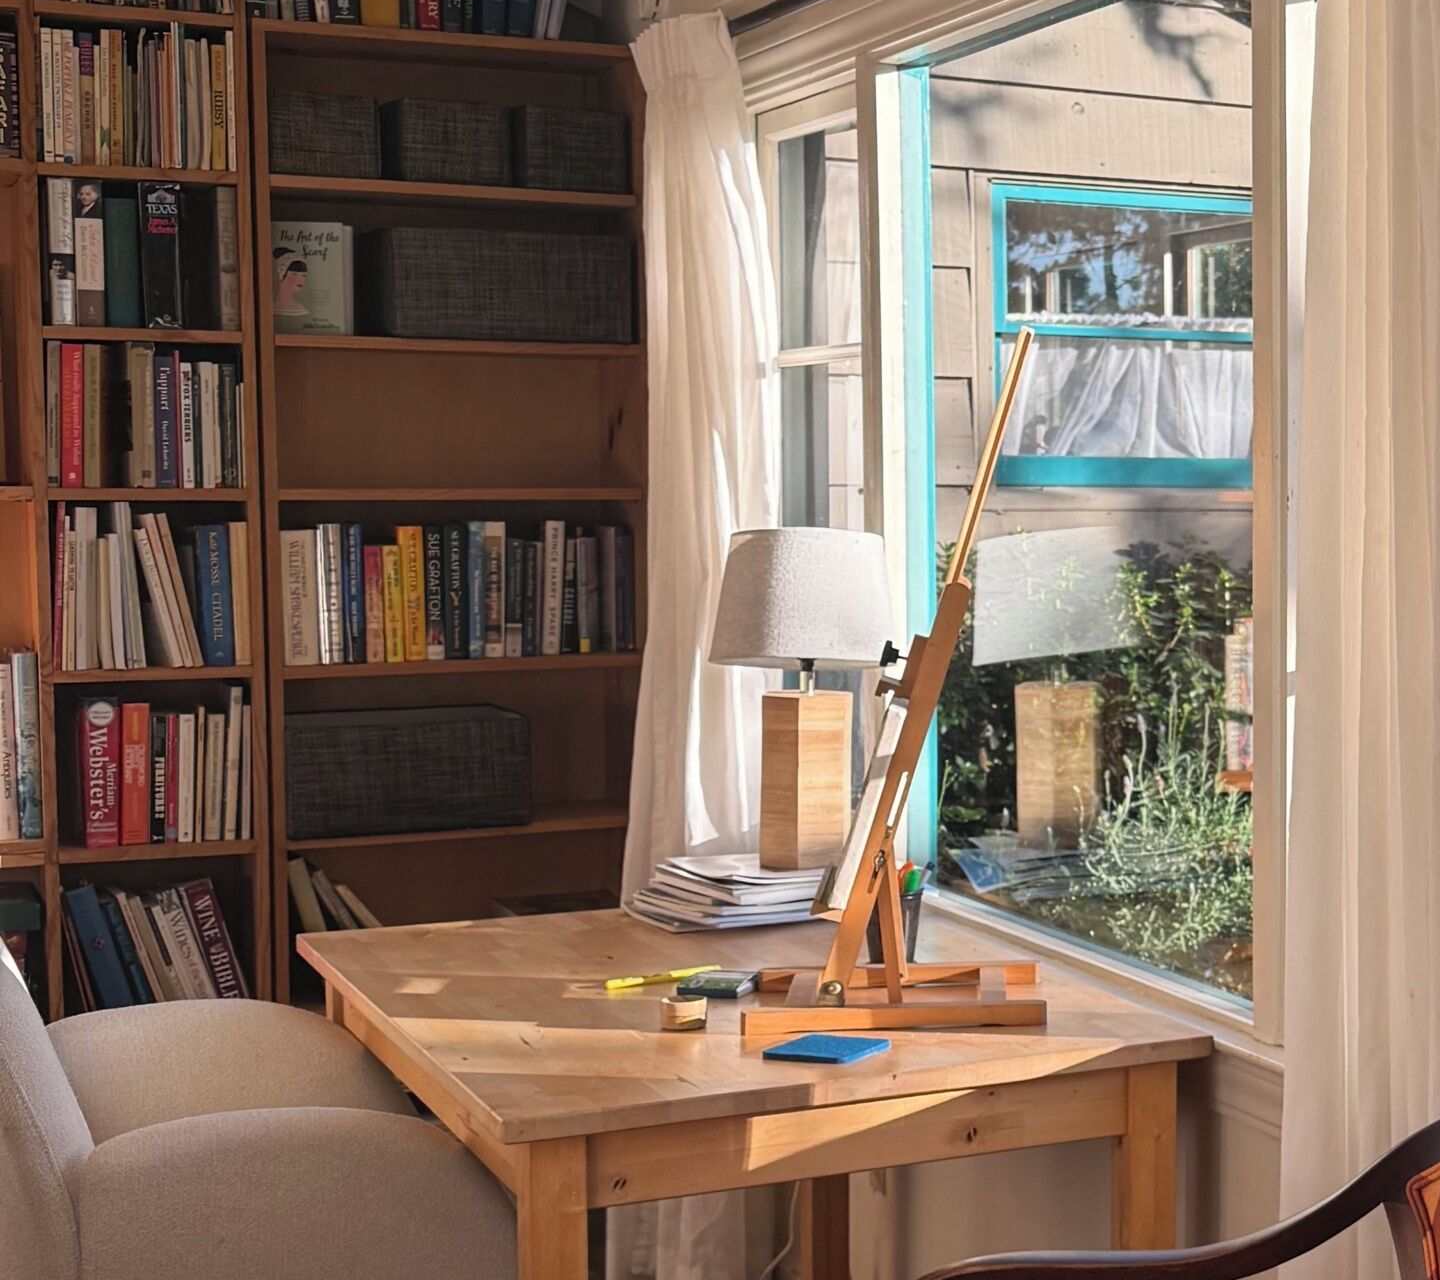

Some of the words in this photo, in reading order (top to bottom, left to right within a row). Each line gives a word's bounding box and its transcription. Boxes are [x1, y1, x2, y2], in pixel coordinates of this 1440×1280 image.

[213, 90, 224, 129] RIBSY
[145, 204, 178, 214] TEXAS
[280, 230, 294, 241] The
[296, 230, 313, 243] Art
[314, 233, 324, 246] of
[326, 231, 340, 242] the
[302, 244, 328, 262] Scarf
[183, 383, 191, 401] FOX
[161, 420, 169, 440] David
[183, 403, 192, 443] TERRIERS
[73, 439, 82, 466] Wuhan
[289, 540, 300, 584] WILLIAM
[428, 533, 440, 557] SUE
[550, 527, 559, 563] PRINCE
[211, 551, 220, 586] MOSSE
[408, 550, 418, 593] GRAFTON
[451, 547, 460, 589] GRAFTON
[550, 567, 558, 599] HARRY
[428, 559, 441, 621] GRAFTON
[211, 592, 224, 641] CITADEL
[290, 587, 302, 658] SHAKESPEARE
[549, 607, 557, 637] SPARE
[1, 751, 13, 799] Antiquities
[89, 727, 110, 820] Webster's
[154, 756, 165, 813] FURNITURE
[170, 911, 193, 960] Wines
[193, 895, 221, 942] WINE
